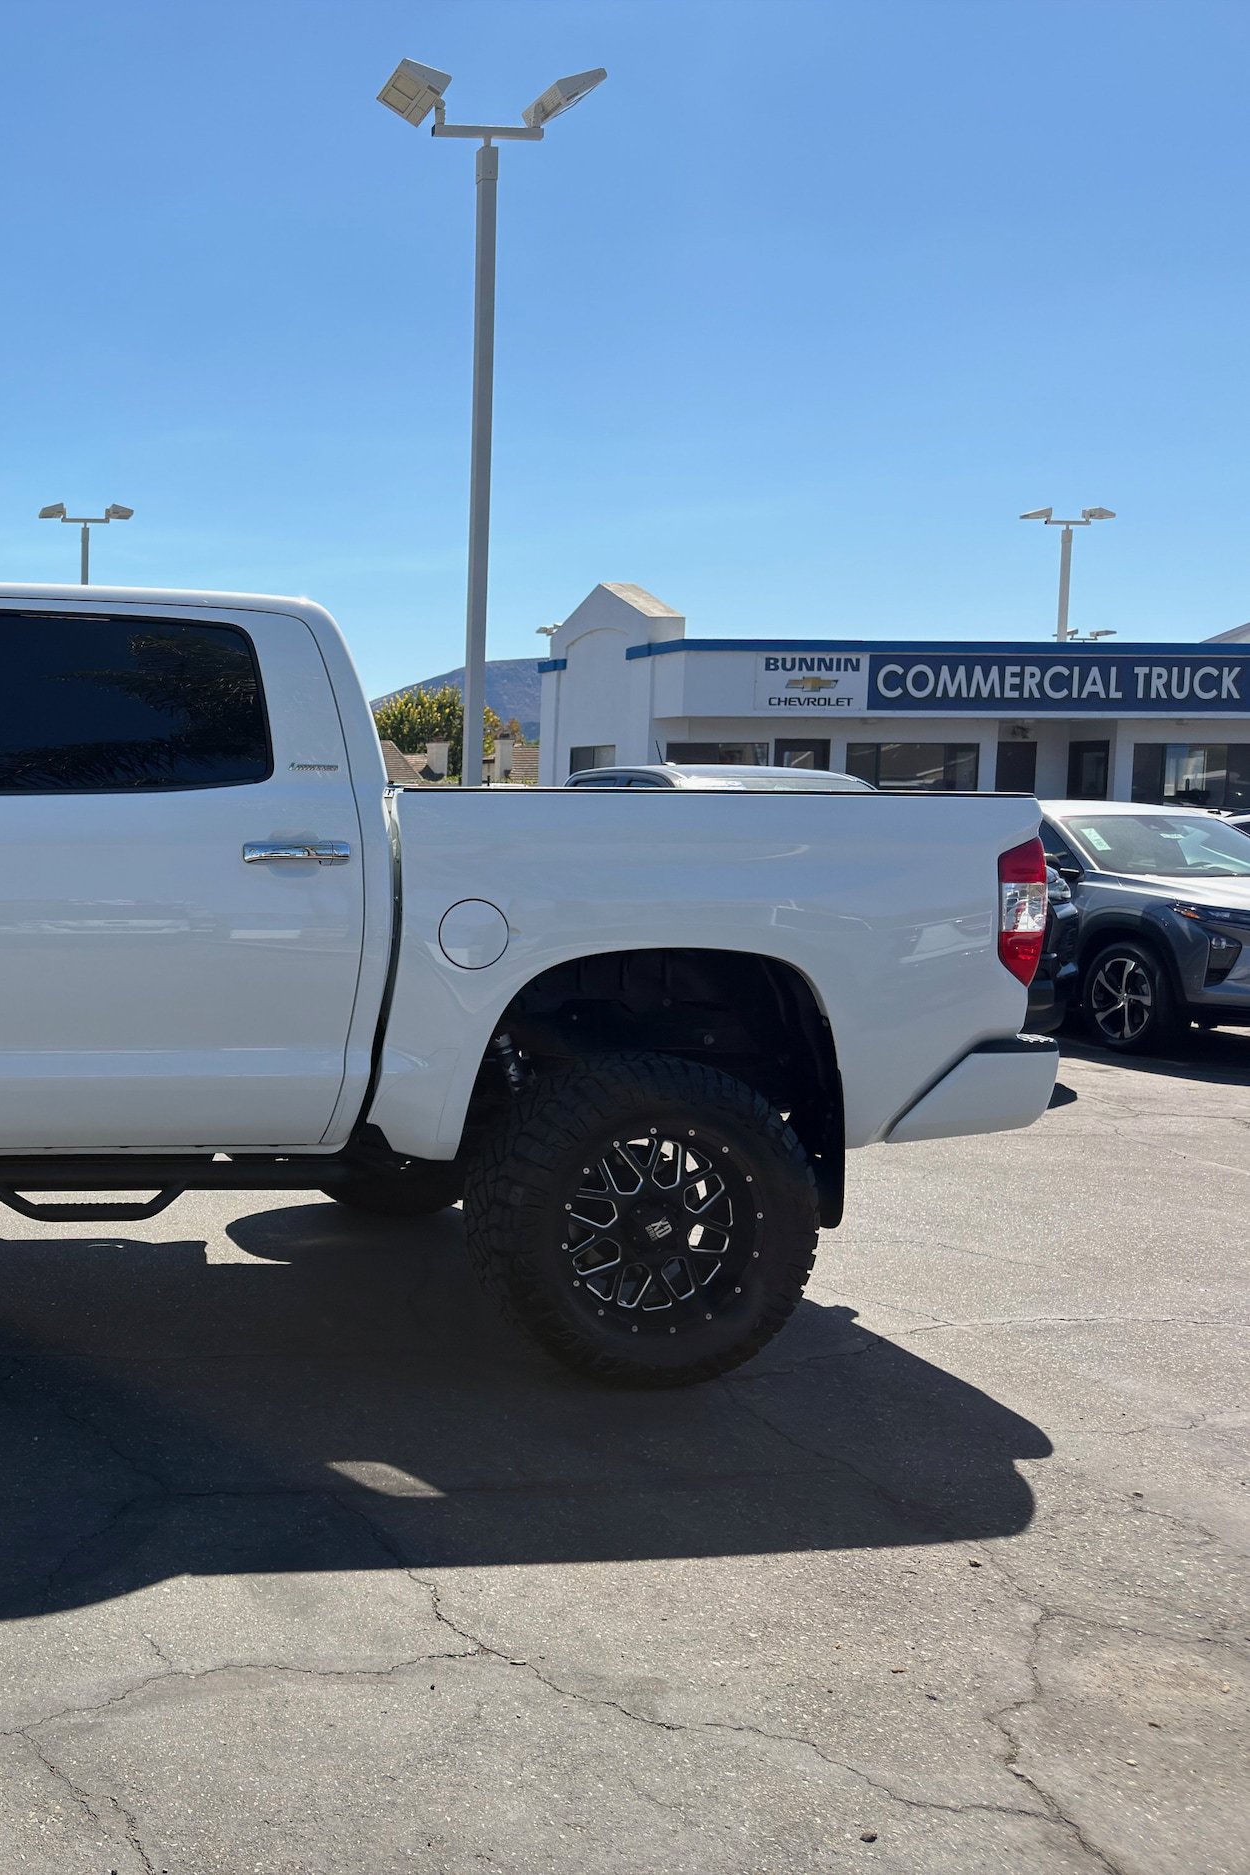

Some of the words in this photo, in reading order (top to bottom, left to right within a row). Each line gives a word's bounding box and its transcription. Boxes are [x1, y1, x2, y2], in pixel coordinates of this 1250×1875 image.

[765, 657, 861, 672] BUNNIN
[876, 663, 1124, 699] COMMERCIAL
[1133, 666, 1242, 699] TRUCK
[768, 697, 854, 707] CHEVROLET
